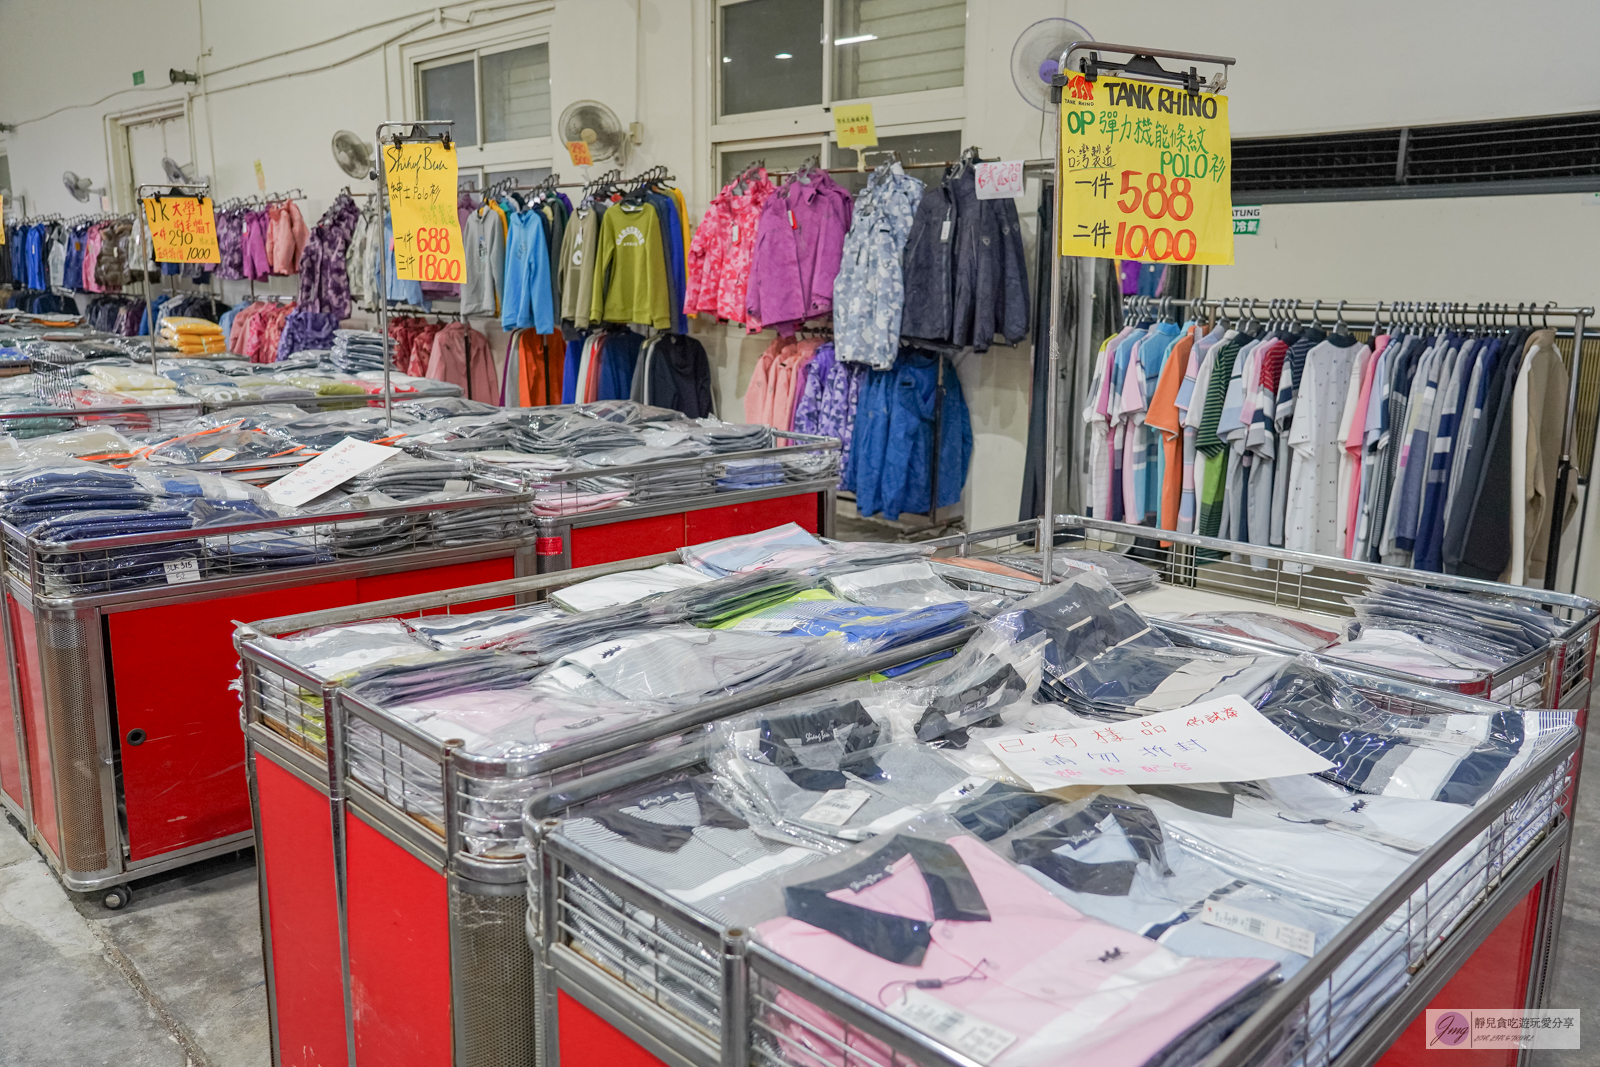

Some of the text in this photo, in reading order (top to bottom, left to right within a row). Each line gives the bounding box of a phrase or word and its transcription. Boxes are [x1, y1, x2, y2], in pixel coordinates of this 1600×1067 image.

[1064, 98, 1077, 106] TANK
[1103, 82, 1217, 119] TANK RHINO
[1067, 110, 1209, 154] OP 彈力機能條紋
[1067, 143, 1116, 168] 台灣製造
[1160, 150, 1226, 183] POLO衫
[1075, 170, 1194, 221] 一件 588
[150, 200, 170, 223] JK
[169, 229, 193, 246] 290
[416, 227, 450, 255] 688
[1073, 220, 1197, 261] 二件 1000
[187, 247, 210, 261] 1000
[418, 254, 461, 281] 1800
